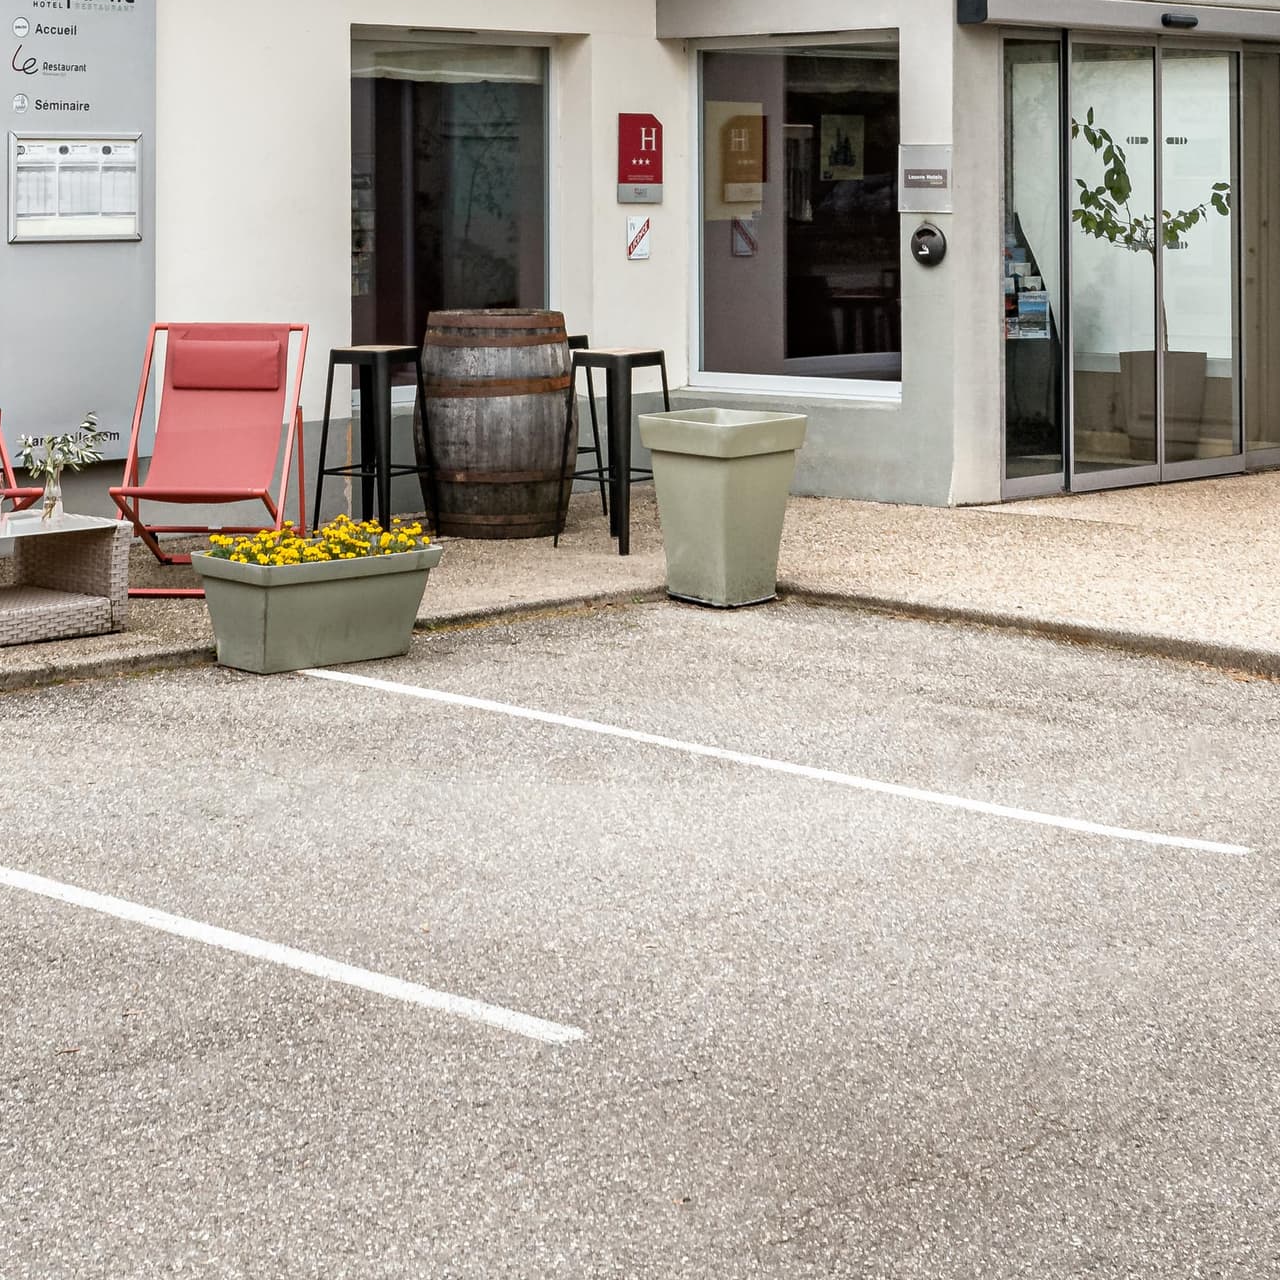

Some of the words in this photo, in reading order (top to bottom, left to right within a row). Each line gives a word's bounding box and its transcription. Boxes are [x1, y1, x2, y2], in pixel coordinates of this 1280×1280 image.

[33, 1, 63, 9] HOTEL
[74, 2, 135, 12] RESTAURANT
[35, 23, 77, 36] Accueil
[12, 44, 39, 75] Le
[42, 61, 87, 72] Restaurant
[34, 99, 90, 111] Séminaire
[640, 127, 657, 151] H
